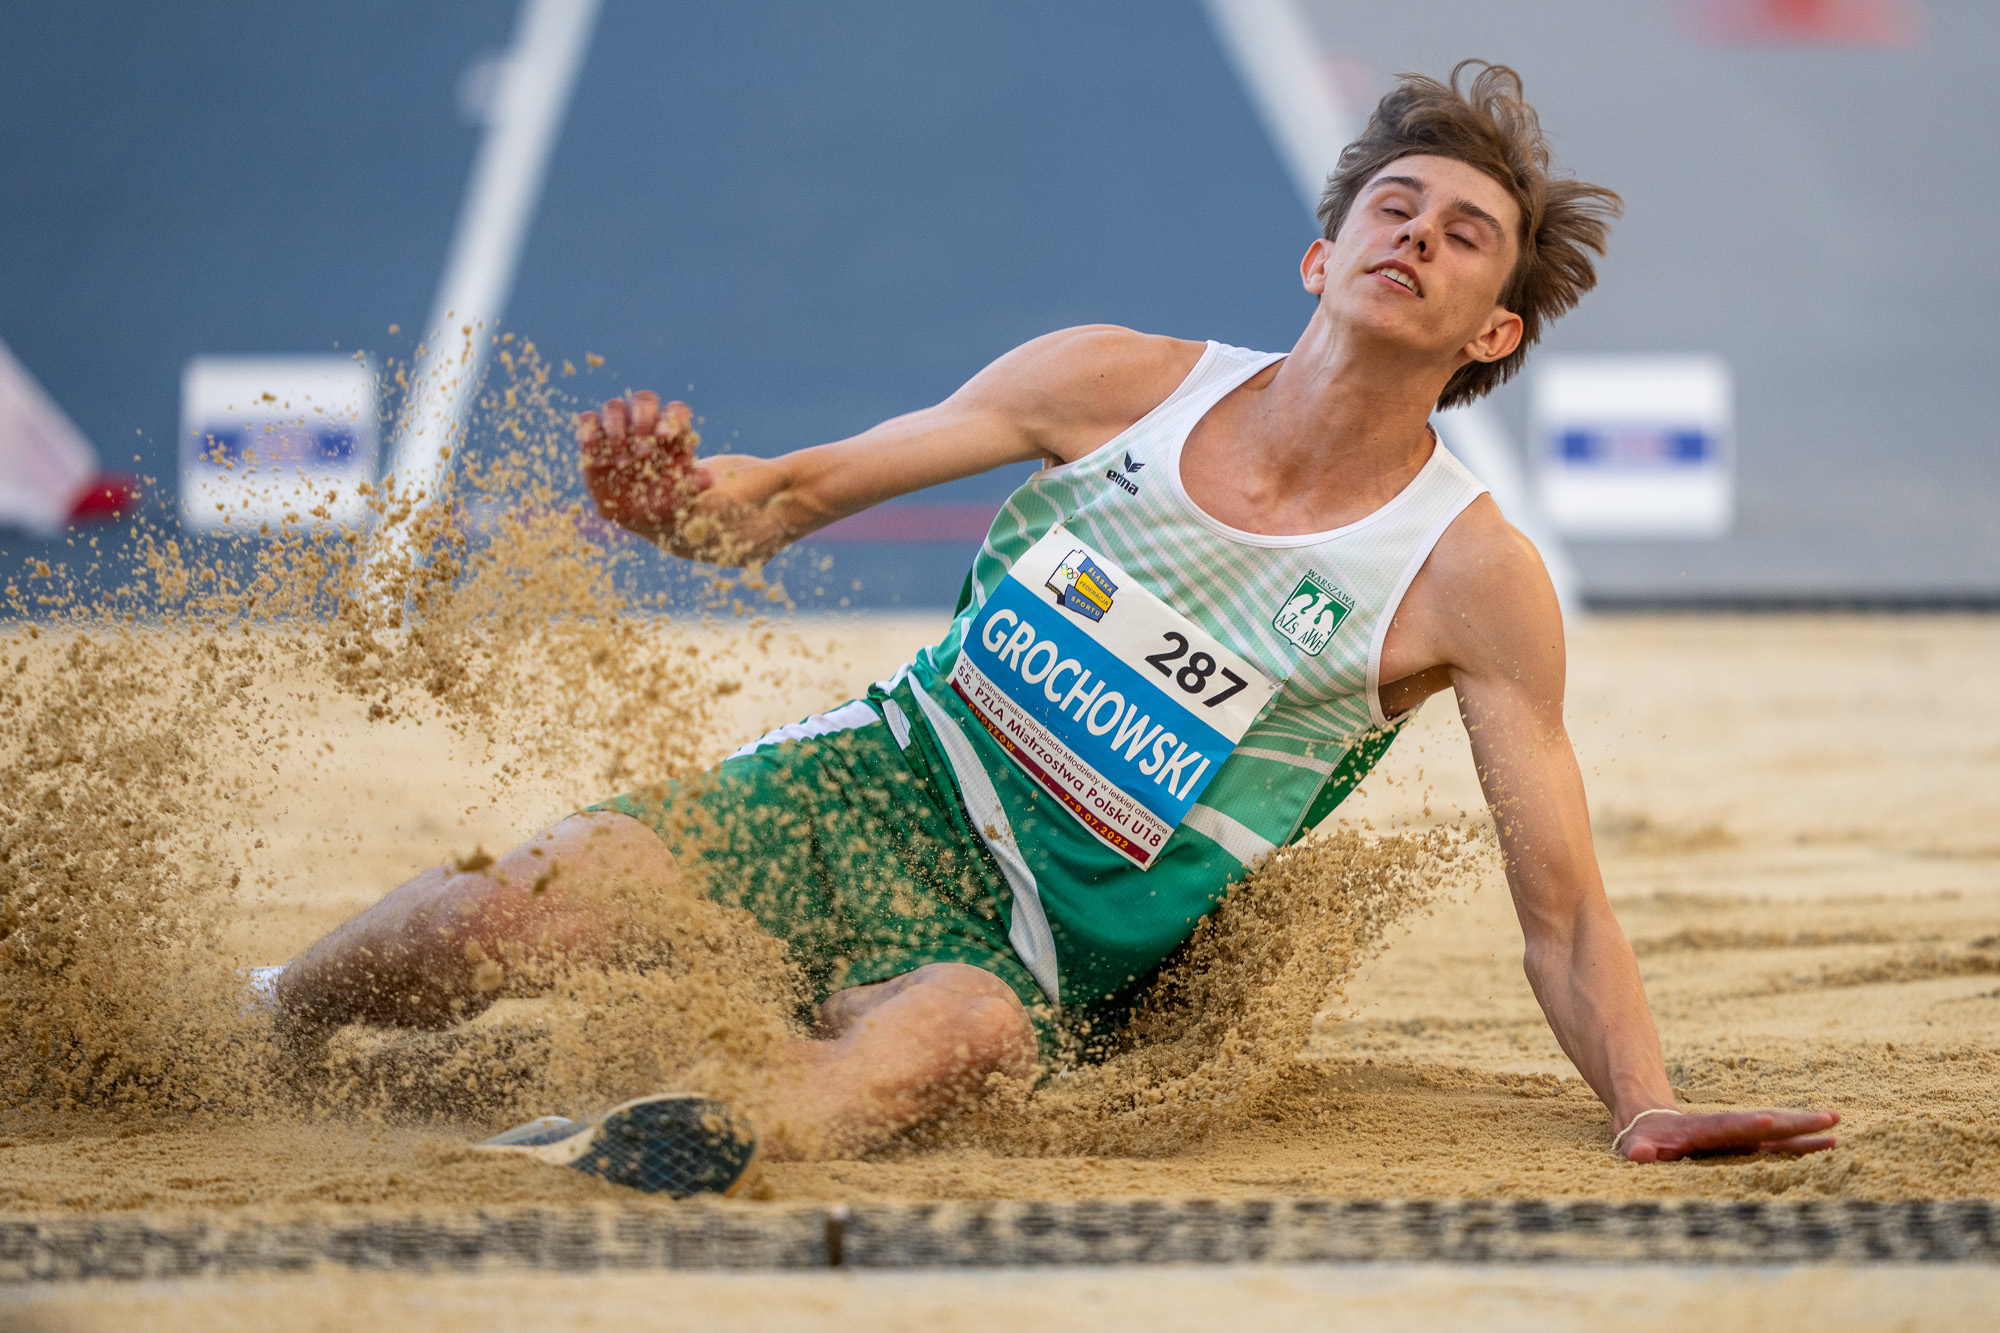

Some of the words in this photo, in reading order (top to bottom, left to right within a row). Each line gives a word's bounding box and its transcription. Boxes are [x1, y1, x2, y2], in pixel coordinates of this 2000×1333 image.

[1106, 469, 1139, 496] erima
[1071, 596, 1100, 616] SPORTU
[1079, 580, 1109, 606] FEDERACJA
[1307, 569, 1355, 608] WARSZAWA
[1276, 612, 1300, 635] AZS
[1298, 628, 1323, 652] AWF
[1145, 631, 1248, 708] 287
[982, 608, 1211, 801] GROCHOWSKI
[962, 655, 975, 674] XXIX
[975, 672, 1023, 720] Ogólnopolska
[1024, 718, 1063, 754] Olimpiada
[1063, 752, 1100, 785] Młodzieży
[1101, 782, 1109, 791] w
[1109, 788, 1135, 812] lekkiej
[1134, 807, 1168, 835] atletyce
[968, 703, 1016, 752] CHORZÓW
[958, 665, 972, 689] 55.
[975, 686, 1004, 721] PZLA
[1006, 719, 1084, 792] Mistrzostwa
[1085, 787, 1131, 826] Polski
[1131, 820, 1162, 847] U18
